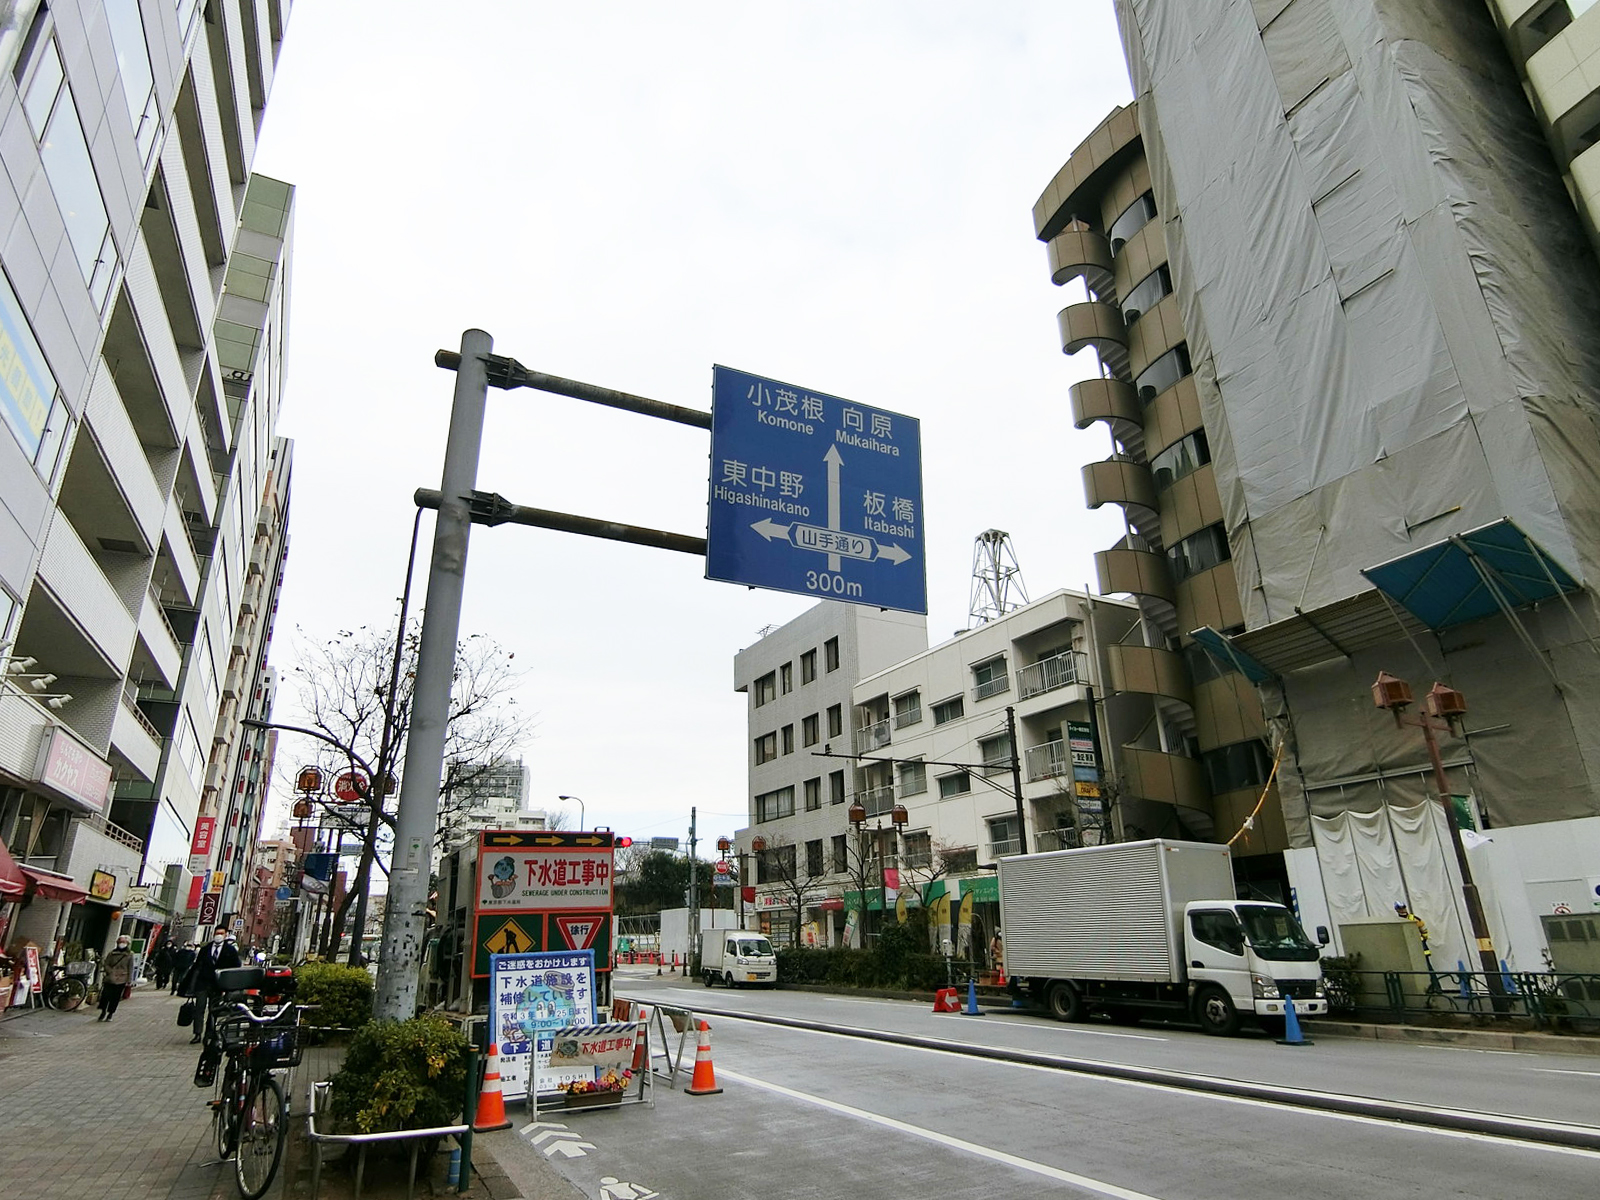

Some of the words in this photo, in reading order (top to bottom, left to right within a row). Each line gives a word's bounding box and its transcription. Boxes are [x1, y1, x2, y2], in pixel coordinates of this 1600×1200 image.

[747, 383, 825, 423] 小茂根
[843, 407, 893, 440] 向原
[758, 410, 814, 435] Komone
[836, 429, 900, 457] Mukaihara
[722, 459, 804, 499] 東中野
[714, 484, 810, 518] Higashinakano
[863, 490, 914, 524] 板橋
[864, 516, 915, 539] Itabashi
[802, 529, 865, 554] 山手通り
[806, 570, 863, 597] 300m
[196, 822, 210, 849] 美容室
[524, 858, 609, 887] 下水道工事中
[522, 889, 549, 897] SEWERAGE
[570, 925, 589, 935] 徐行
[498, 957, 587, 970] ご迷惑をおかけします
[500, 972, 587, 989] 下水道施設を
[500, 987, 587, 1006] 補修しています
[581, 1036, 632, 1055] 下水道工事中
